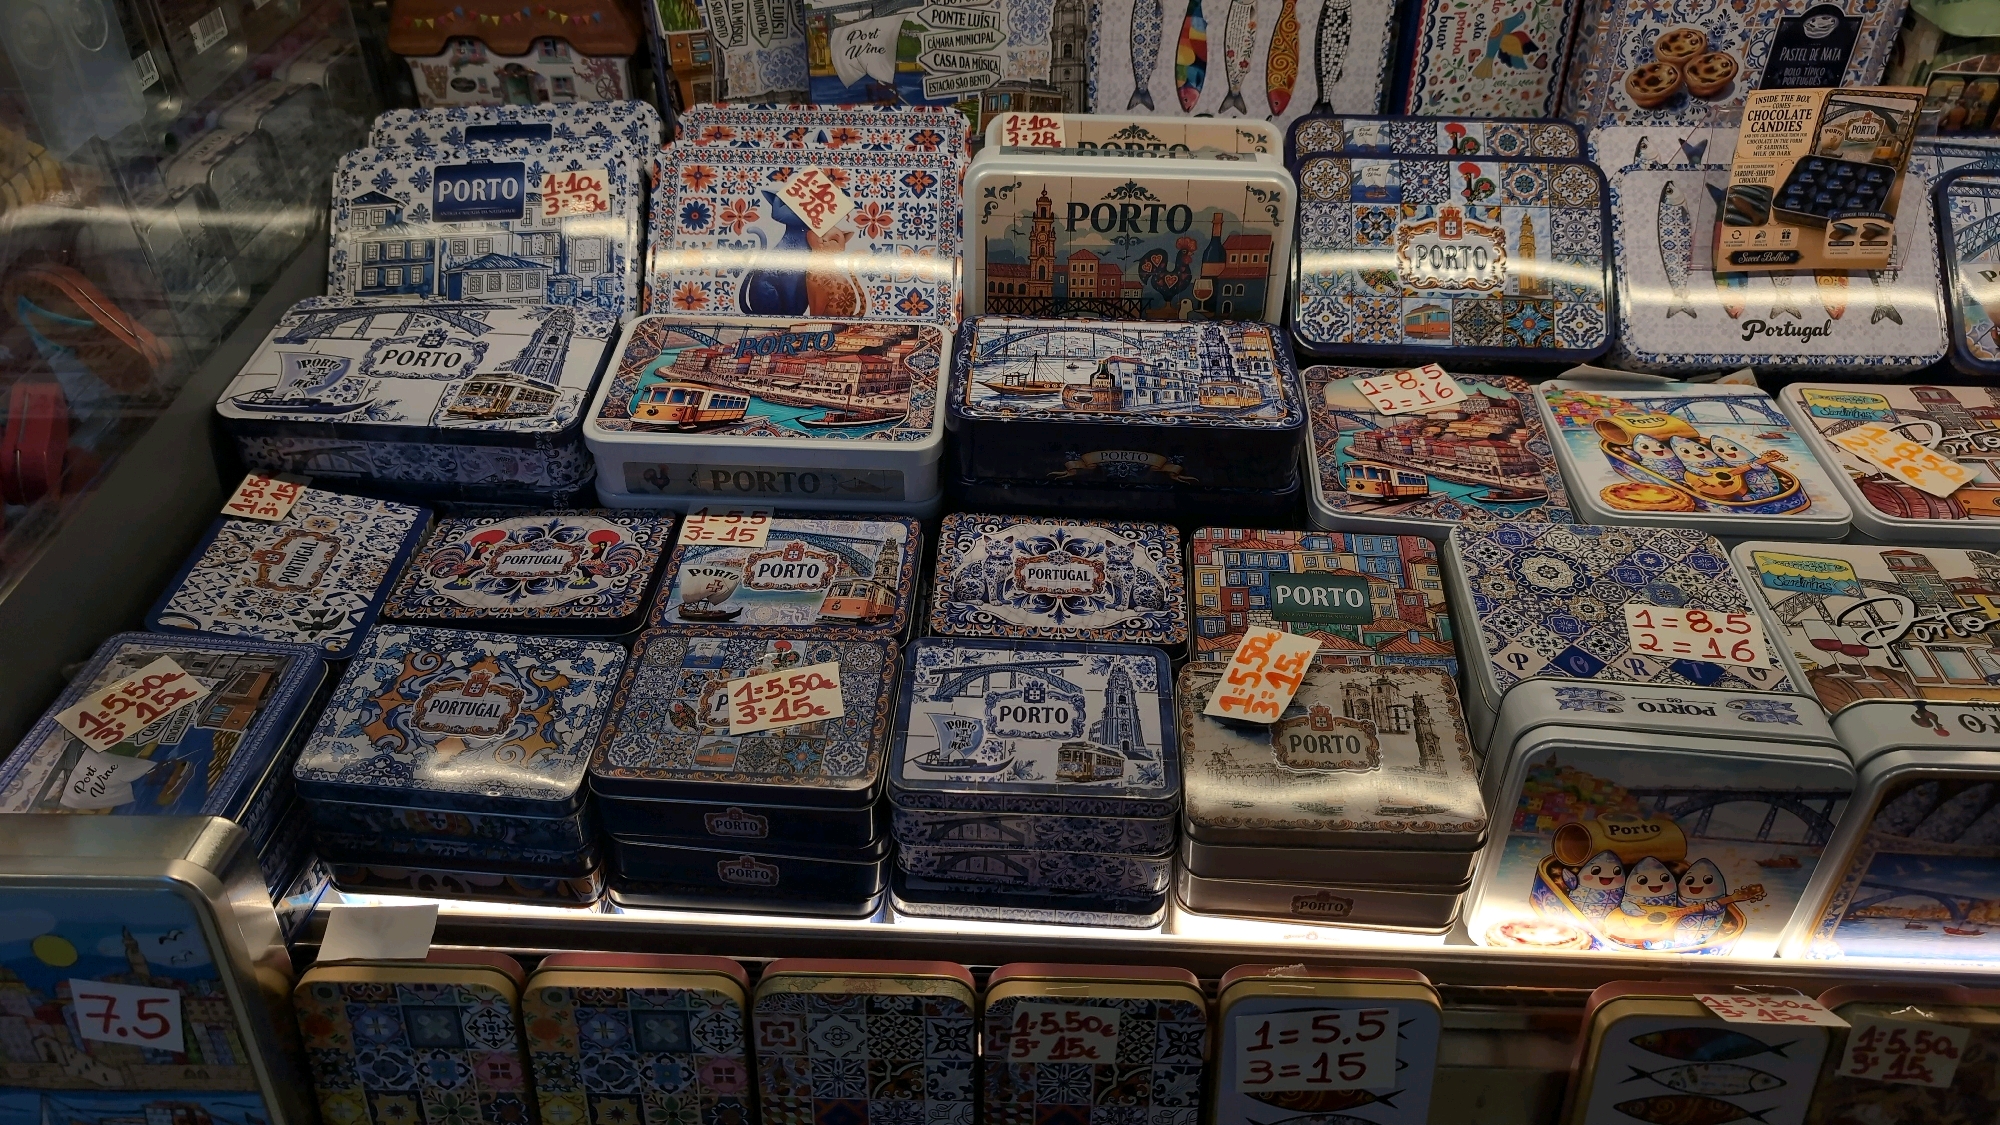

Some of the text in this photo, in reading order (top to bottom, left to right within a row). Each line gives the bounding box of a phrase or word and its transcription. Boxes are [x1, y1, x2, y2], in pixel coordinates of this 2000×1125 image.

[714, 16, 729, 38] BENTO
[753, 0, 770, 38] UNICIPAL
[931, 9, 966, 26] PONTE
[967, 12, 990, 28] LUÍS
[1472, 13, 1487, 41] esta
[846, 28, 881, 44] Port
[927, 31, 996, 49] CÂMARA MUNICIPAL
[1452, 11, 1468, 56] pomba
[844, 42, 886, 60] Wine
[933, 53, 957, 68] CASA
[959, 56, 971, 69] DA
[1783, 67, 1802, 77] BOLO
[969, 74, 991, 88] BENTO
[1755, 95, 1779, 104] INSIDE
[1796, 95, 1812, 103] BOX
[1747, 108, 1813, 121] CHOCOLATE
[1750, 121, 1803, 133] CANDIES
[1824, 128, 1844, 137] PORTO
[1851, 124, 1876, 135] PORTO
[437, 177, 519, 203] PORTO
[1064, 202, 1193, 234] PORTO
[1415, 244, 1489, 272] PORTO
[1738, 251, 1761, 264] Sweet
[1741, 318, 1833, 344] Portugal
[735, 329, 837, 358] PORTO
[300, 358, 342, 371] PORTO
[378, 348, 463, 370] PORTO
[1820, 407, 1873, 419] Sardinhas
[1099, 451, 1150, 463] PORTO
[709, 468, 821, 494] PORTO
[277, 540, 320, 584] PORTUGAL
[501, 555, 564, 565] PORTUGAL
[688, 567, 740, 581] PORTO
[757, 563, 820, 579] PORTO
[1027, 568, 1091, 582] PORTUGAL
[1773, 574, 1833, 594] Sardinhas
[1275, 584, 1364, 608] PORTO
[1835, 594, 2000, 669] Porto
[428, 699, 501, 719] PORTUGAL
[999, 705, 1069, 724] PORTO
[1637, 700, 1718, 717] PORTO
[947, 720, 977, 731] PORTO
[950, 740, 972, 750] WINE
[1288, 733, 1361, 755] PORTO
[74, 765, 97, 794] Port
[90, 764, 119, 798] Wine
[714, 819, 758, 833] PORTO
[1608, 822, 1661, 837] Porto
[727, 867, 769, 880] PORTO
[1299, 900, 1344, 912] PORTO
[79, 993, 171, 1039] 7.5
